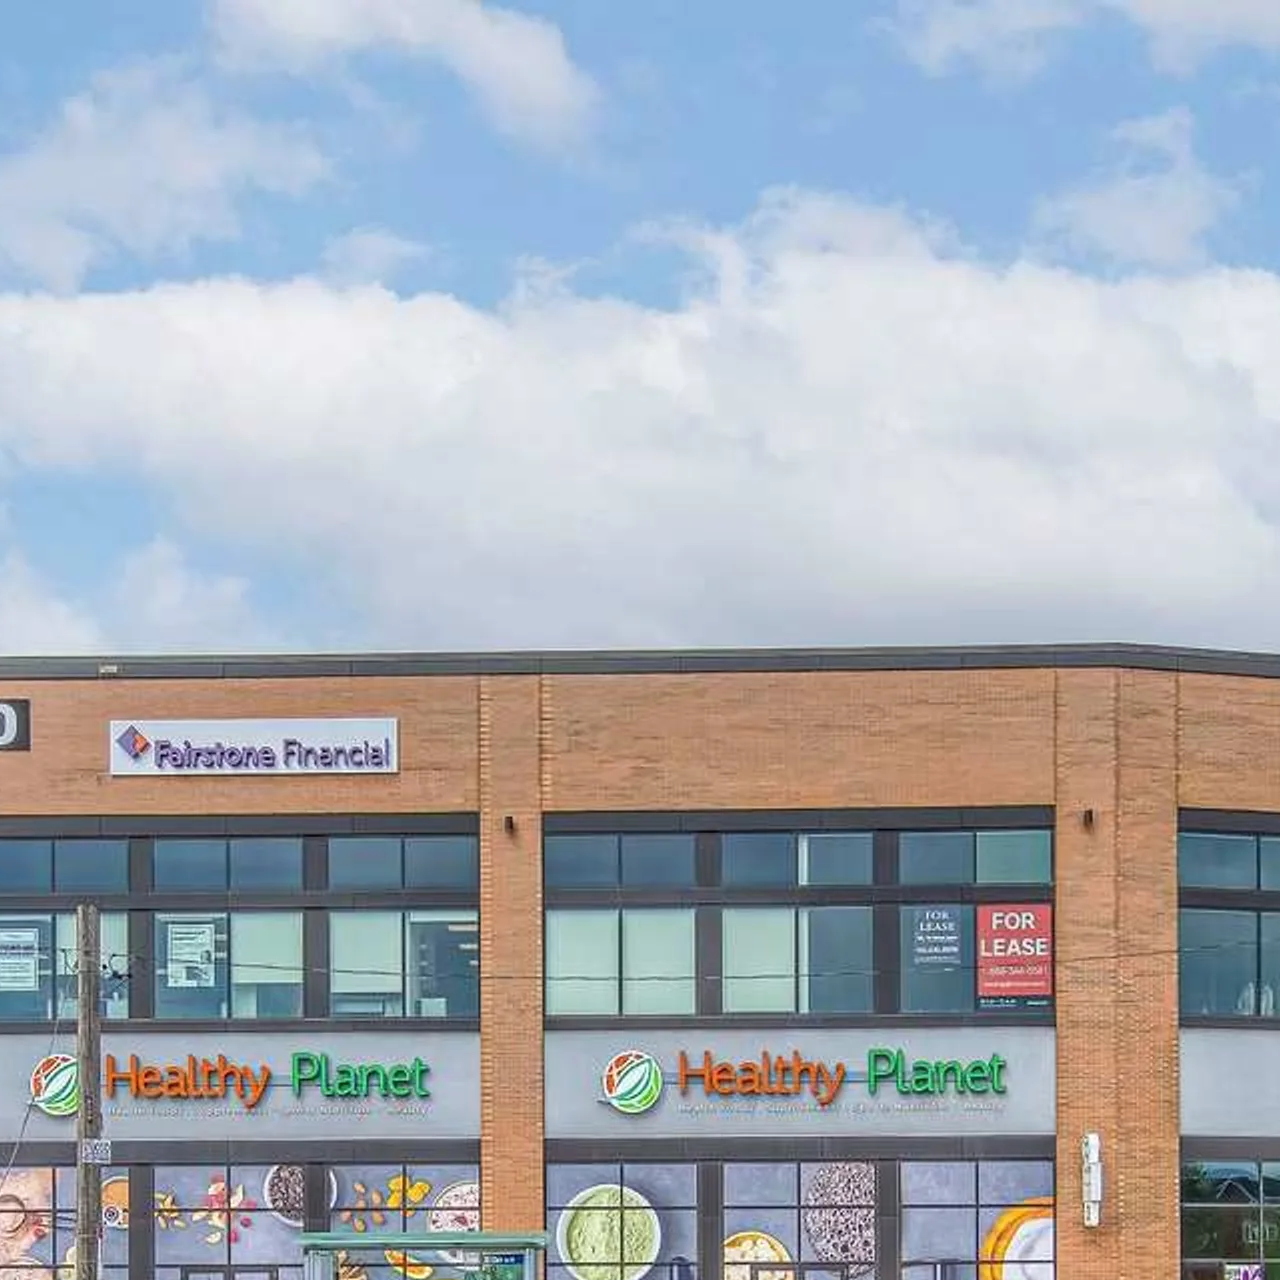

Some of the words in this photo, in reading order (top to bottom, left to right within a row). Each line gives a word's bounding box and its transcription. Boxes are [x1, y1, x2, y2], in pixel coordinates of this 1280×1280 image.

[153, 738, 277, 769] Fairstone
[282, 736, 391, 768] Financial
[919, 921, 956, 932] LEASE
[991, 911, 1036, 931] FOR
[980, 937, 1050, 957] LEASE
[104, 1053, 271, 1109] Healthy
[290, 1051, 431, 1099] Planet
[676, 1049, 846, 1109] Healthy
[866, 1047, 1008, 1097] Planet
